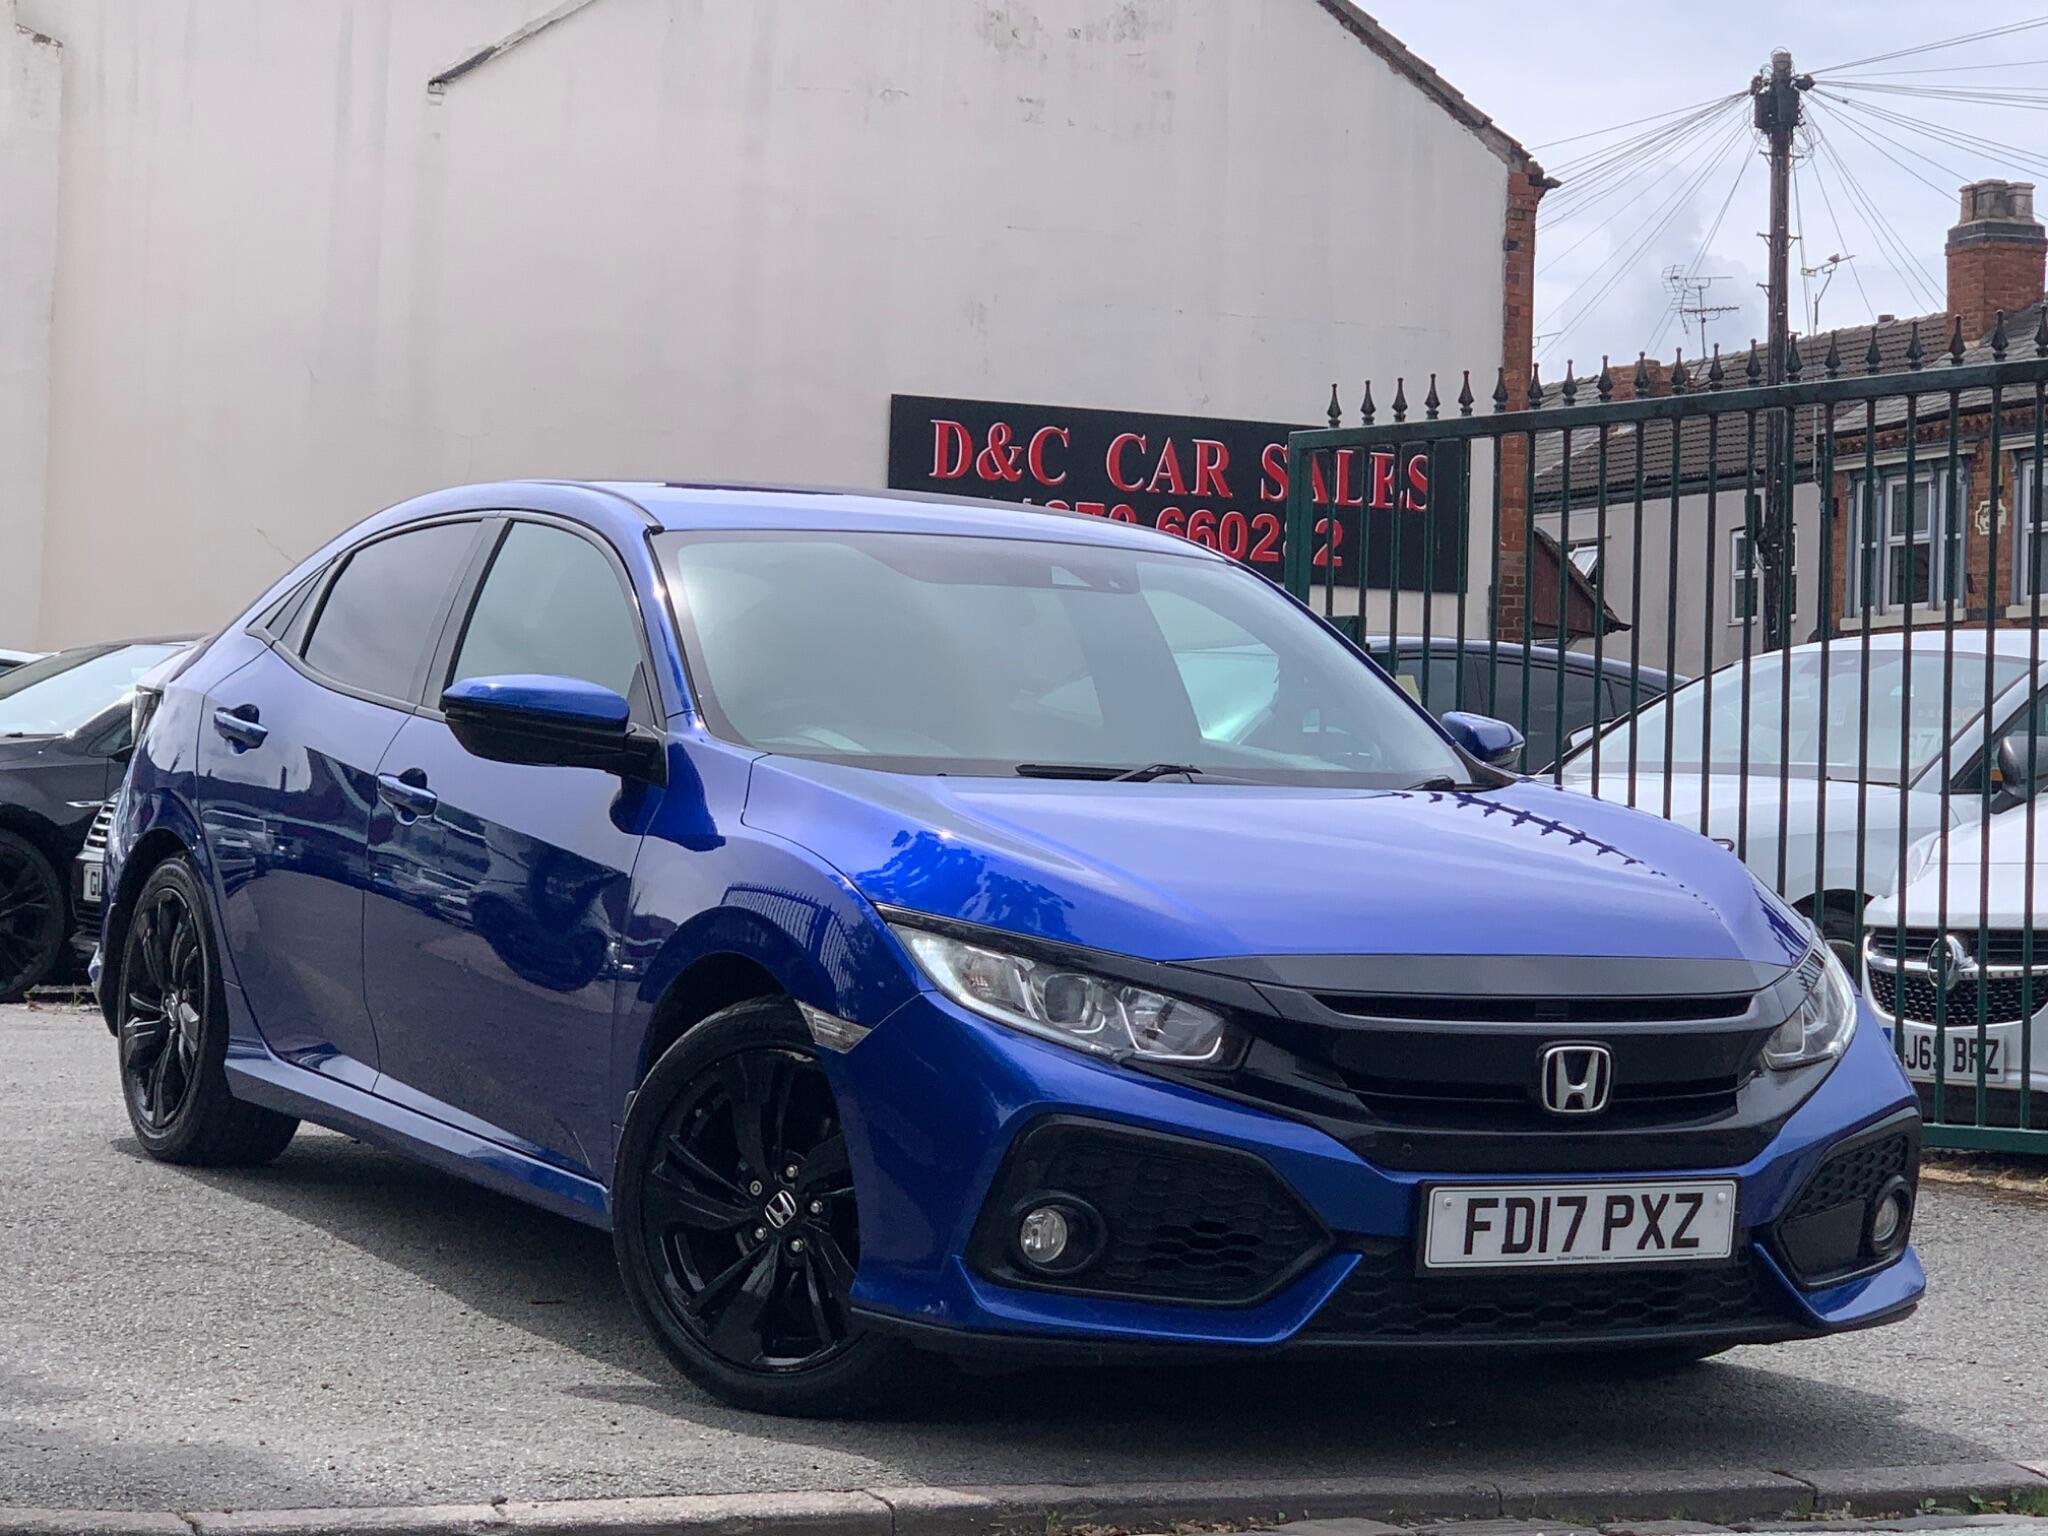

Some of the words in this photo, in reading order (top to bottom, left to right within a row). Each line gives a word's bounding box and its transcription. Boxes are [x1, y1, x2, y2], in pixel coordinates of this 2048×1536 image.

[929, 419, 1070, 486] D&C
[1106, 433, 1234, 498] CAR
[1155, 506, 1344, 567] 66022
[1463, 1196, 1588, 1255] FD17
[1602, 1192, 1704, 1251] PXZ
